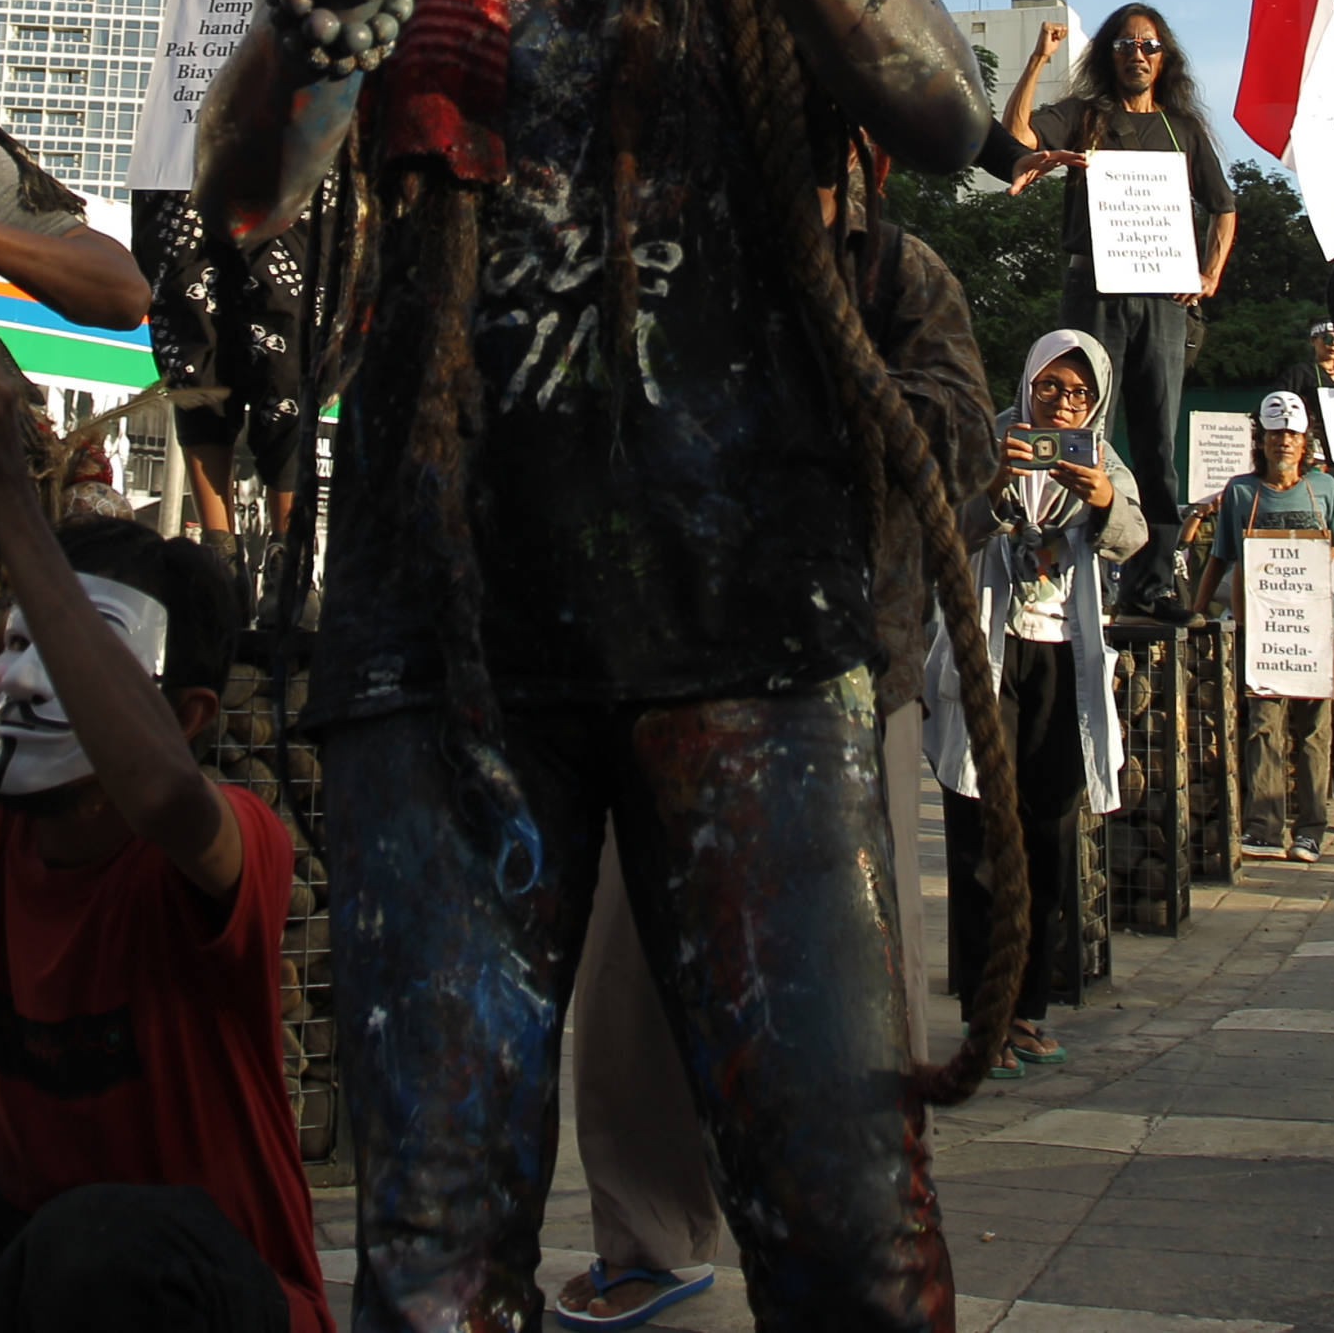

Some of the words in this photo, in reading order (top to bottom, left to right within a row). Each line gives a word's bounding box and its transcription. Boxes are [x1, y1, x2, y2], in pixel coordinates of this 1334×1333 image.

[164, 41, 198, 58] Pak
[1104, 170, 1168, 183] Seniman
[1124, 185, 1151, 197] dan
[1098, 200, 1181, 214] Budayawan
[1110, 216, 1171, 228] menolak
[1116, 231, 1168, 244] Jakpro
[1107, 246, 1182, 260] mengelola
[1131, 262, 1161, 274] TIM
[1268, 548, 1299, 559] TIM
[1263, 563, 1307, 577] Cagar
[1259, 578, 1314, 594] Budaya
[1269, 606, 1305, 620] yang
[1264, 620, 1310, 634] Harus
[1261, 642, 1312, 656] Disela-
[1256, 659, 1318, 673] matkan!
